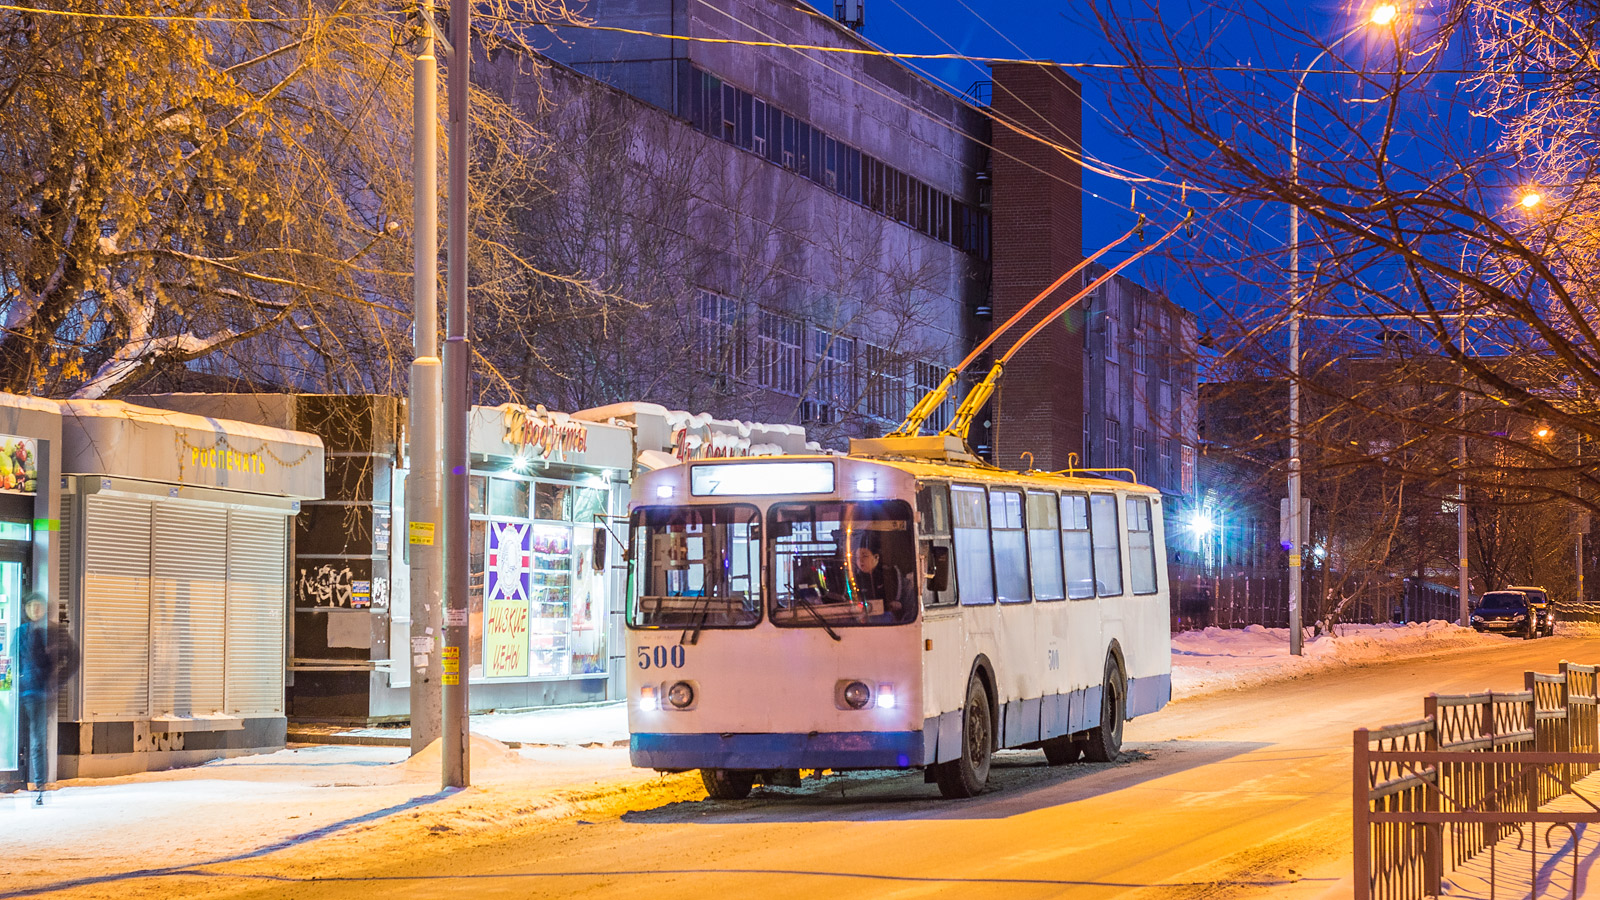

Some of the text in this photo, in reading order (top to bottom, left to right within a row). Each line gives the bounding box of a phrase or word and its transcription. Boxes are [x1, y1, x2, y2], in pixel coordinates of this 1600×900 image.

[191, 447, 266, 475] РОСПЕЧАТЬ
[708, 480, 721, 494] 7
[488, 607, 527, 639] НИЗКИЕ
[493, 644, 521, 676] ЦЕНЫ
[638, 644, 686, 670] 500
[1048, 649, 1060, 671] 500
